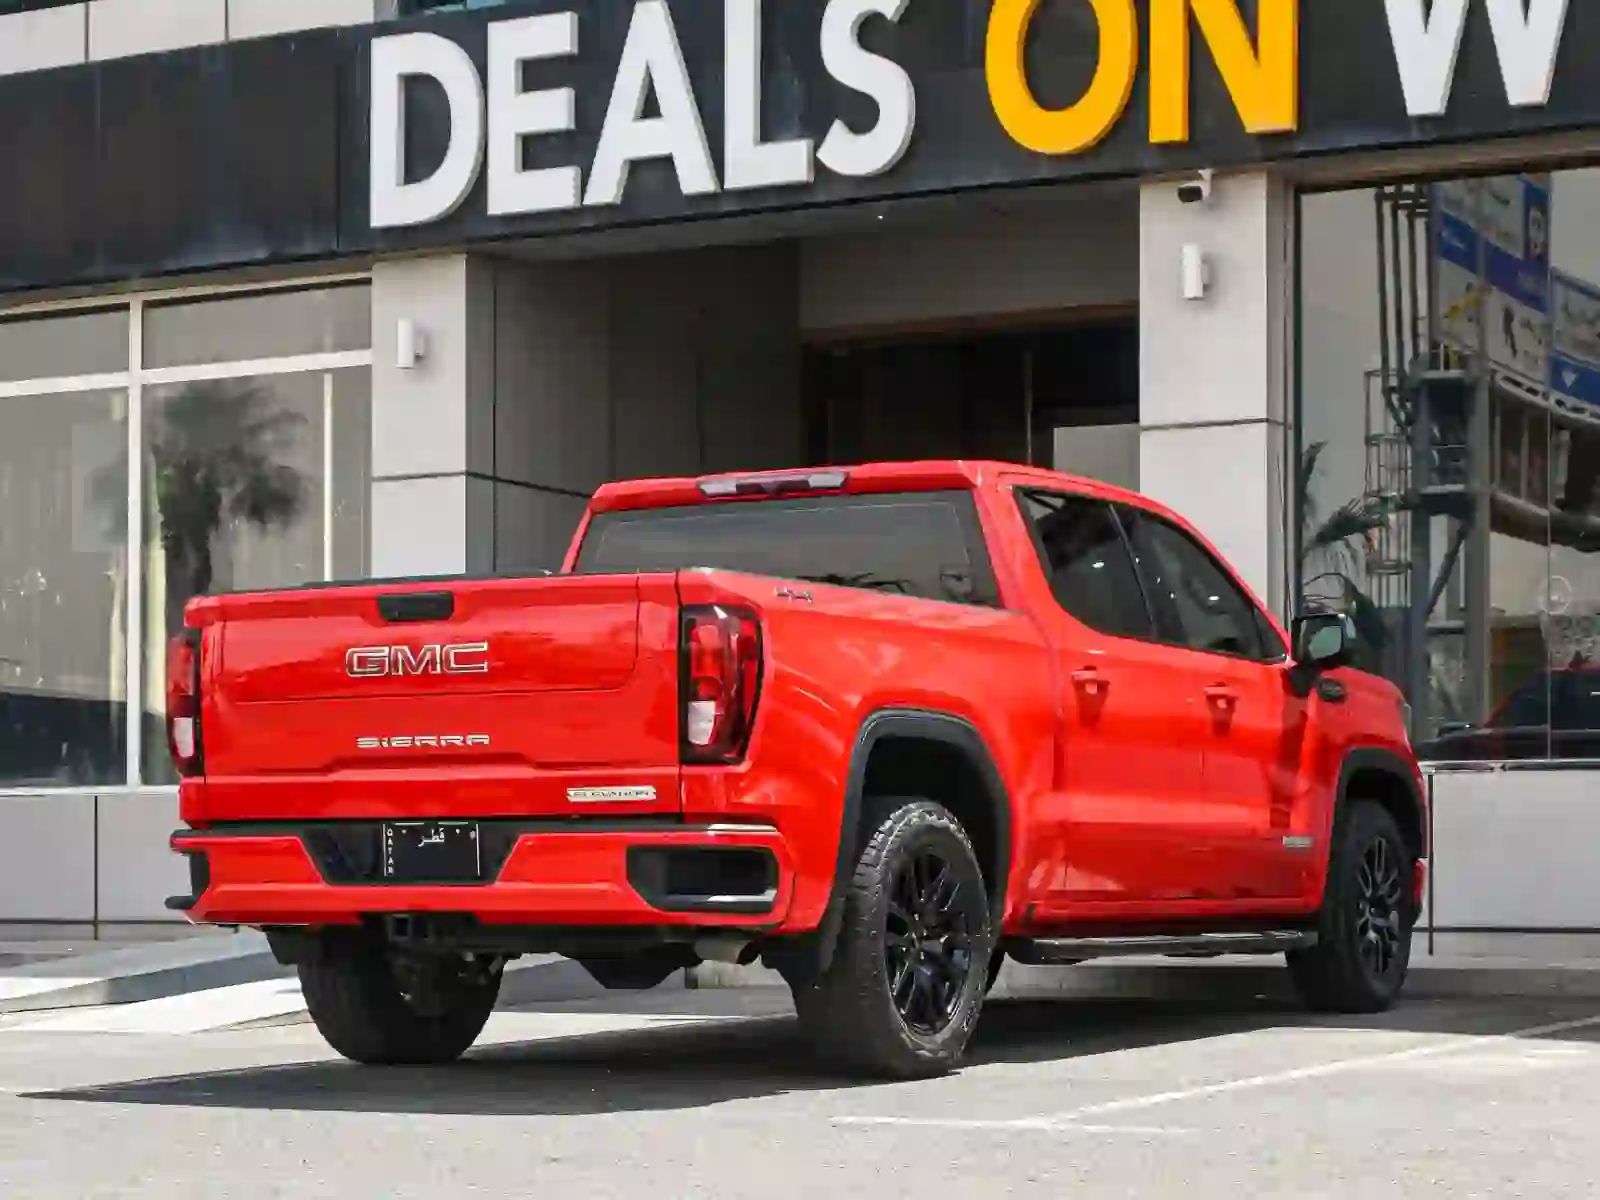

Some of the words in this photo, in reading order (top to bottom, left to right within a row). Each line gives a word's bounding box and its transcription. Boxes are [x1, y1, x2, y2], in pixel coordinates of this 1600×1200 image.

[370, 0, 916, 228] DEALS
[985, 0, 1299, 156] ON
[1385, 0, 1569, 117] W
[345, 641, 489, 677] GMC
[357, 733, 490, 748] SIERRA
[416, 827, 445, 848] قطر
